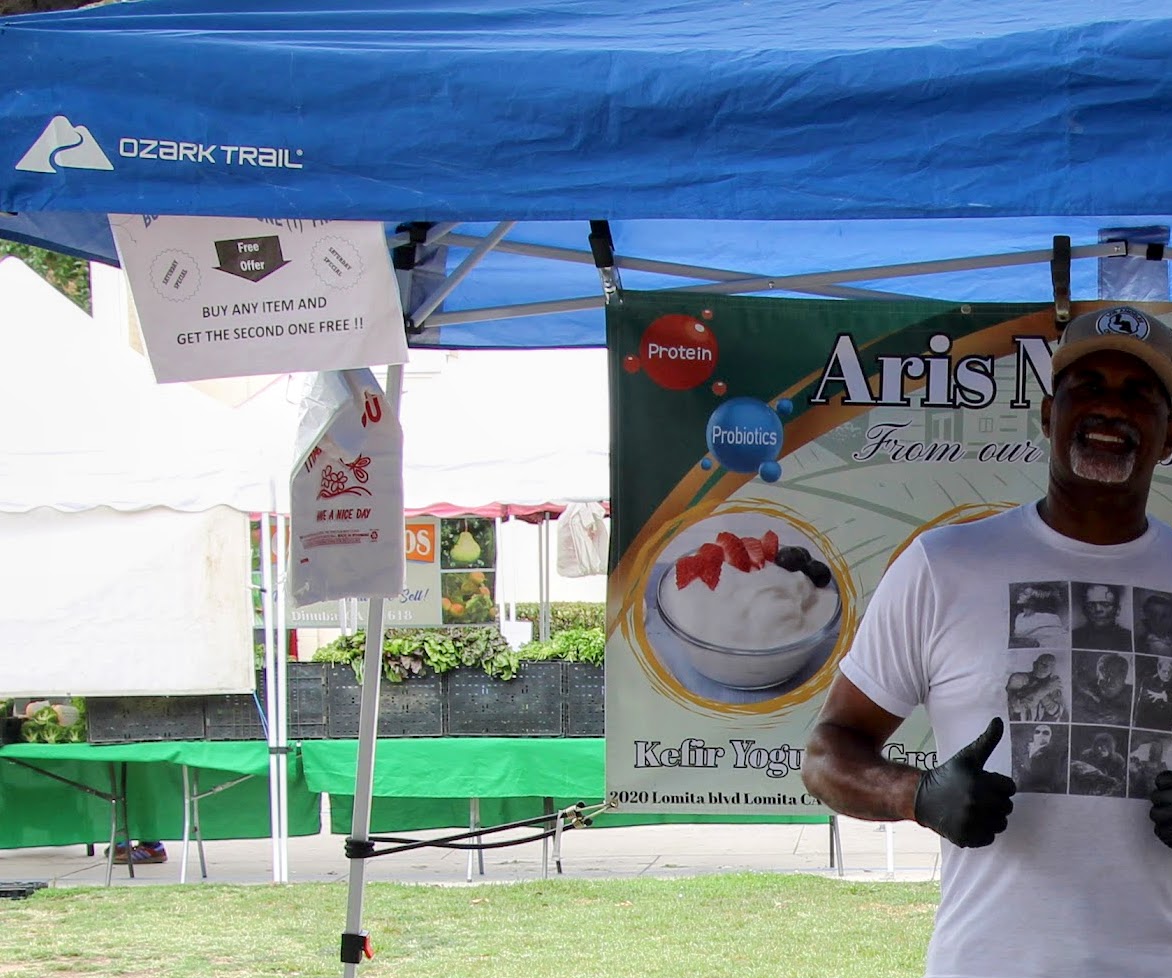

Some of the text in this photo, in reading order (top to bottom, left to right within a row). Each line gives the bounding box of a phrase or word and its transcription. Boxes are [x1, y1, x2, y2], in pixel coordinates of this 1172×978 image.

[119, 137, 217, 164] OZARK
[238, 240, 260, 253] Free
[239, 258, 265, 272] Offer
[322, 256, 343, 278] SPECIAL
[327, 246, 353, 271] SATURDAY
[162, 259, 179, 286] SATURDAY
[173, 268, 188, 290] SPECIAL
[202, 296, 328, 319] BUY ANY ITEM AND
[176, 331, 202, 345] GET
[205, 329, 231, 342] THE
[233, 325, 284, 341] SECOND
[287, 323, 315, 337] ONE
[319, 319, 351, 334] FREE
[647, 342, 713, 362] Protein
[811, 332, 996, 410] Aris
[711, 425, 778, 447] Probiotics
[854, 420, 1042, 463] From our
[336, 508, 354, 520] NICE
[356, 508, 372, 519] DAY
[400, 588, 430, 604] Sell!
[291, 611, 338, 622] Dinuba
[634, 738, 806, 778] Kefir Yogu
[610, 791, 823, 806] 2020 Lomita blvd Lomita CA
